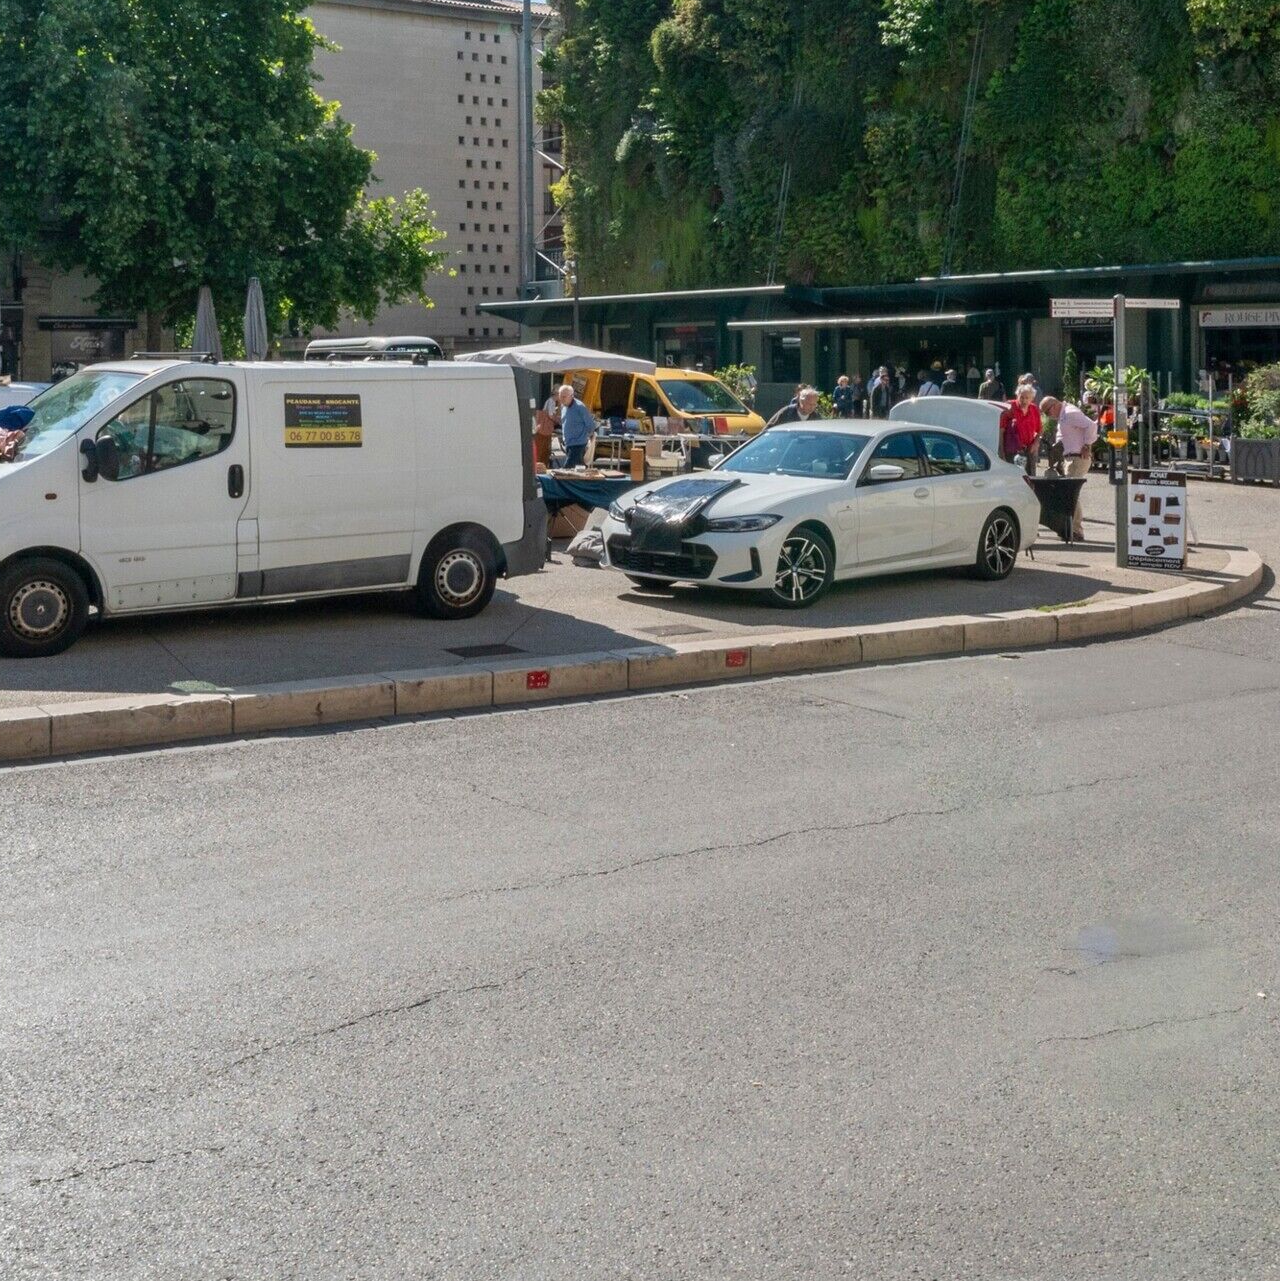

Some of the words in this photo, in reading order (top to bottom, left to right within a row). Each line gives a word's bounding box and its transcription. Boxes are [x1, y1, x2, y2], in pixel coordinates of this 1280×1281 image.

[1224, 312, 1261, 323] ROUGE
[289, 431, 302, 441] 06
[304, 431, 317, 441] 77
[320, 431, 332, 441] 00
[334, 431, 346, 441] 85
[349, 431, 360, 441] 78
[1128, 555, 1180, 565] Déplacement
